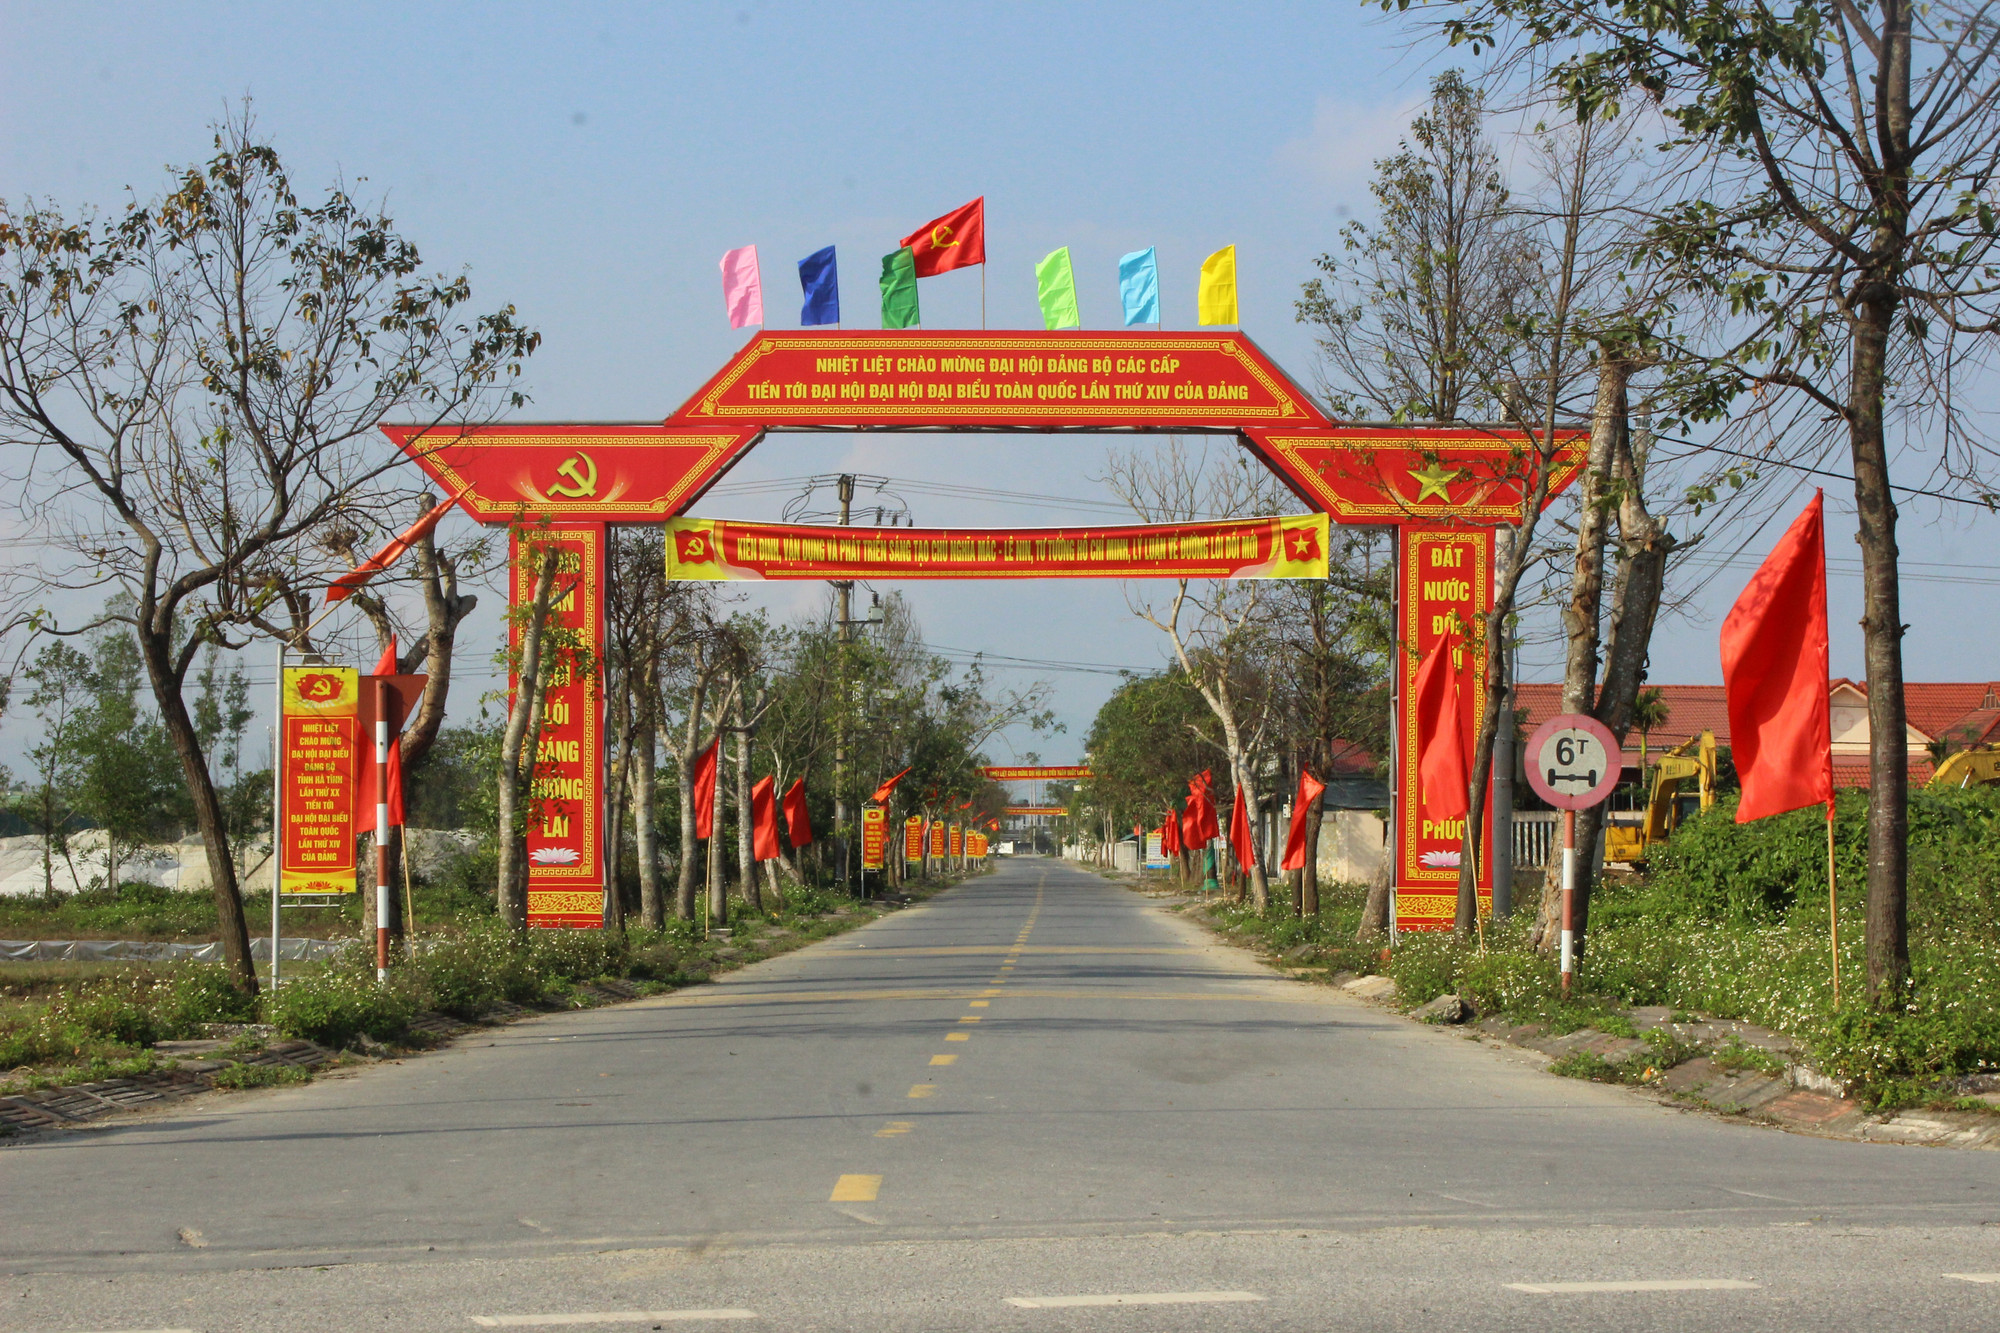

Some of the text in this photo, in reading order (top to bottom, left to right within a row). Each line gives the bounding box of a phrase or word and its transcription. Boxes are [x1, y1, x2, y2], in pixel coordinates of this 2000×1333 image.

[816, 353, 1180, 376] NHIỆT LIỆT CHÀO MỪNG ĐẠI HỘI ĐẢNG BỘ CÁC CẤP
[747, 378, 1248, 401] TIẾN TỚI ĐẠI HỘI ĐẠI HỘI ĐẠI BIỂU TOÀN QUỐC LẦN THỨ XIV CỦA ĐẢNG
[737, 533, 757, 561] KIÊN
[759, 538, 781, 566] ĐỊNH,
[783, 534, 800, 566] VẬN
[802, 539, 825, 567] DỤNG
[827, 534, 838, 561] VÀ
[840, 534, 860, 561] PHÁT
[863, 531, 887, 562] TRIỂN
[889, 534, 911, 562] SÁNG
[913, 540, 929, 567] TẠO
[931, 531, 948, 562] CHỦ
[950, 535, 976, 562] NGHĨA
[977, 535, 996, 562] MÁC
[1004, 535, 1014, 561] LÊ
[1016, 540, 1033, 564] NIN,
[1035, 537, 1047, 561] TƯ
[1048, 530, 1075, 561] TƯỞNG
[1076, 532, 1088, 561] HỒ
[1090, 534, 1104, 561] CHÍ
[1106, 538, 1131, 563] MINH,
[1132, 533, 1142, 560] LÝ
[1144, 533, 1166, 565] LUẬN
[1168, 529, 1178, 560] VỀ
[1180, 530, 1208, 560] ĐƯỜNG
[1210, 528, 1223, 559] LỐI
[1225, 527, 1240, 559] ĐỔI
[1241, 528, 1258, 559] MỚI
[1431, 541, 1463, 567] ĐẤT
[1424, 577, 1470, 601] NƯỚC
[302, 722, 339, 734] NHIỆT LIỆT
[300, 735, 341, 745] CHÀO MỪNG
[536, 736, 579, 762] SÁNG
[292, 746, 349, 760] ĐẠI HỘI ĐẠI BIỂU
[305, 798, 334, 810] TIẾN TỚI
[300, 824, 339, 836] TOÀN QUỐC
[543, 815, 568, 837] LAI
[1422, 816, 1465, 840] PHÚC
[298, 837, 341, 848] LẦN THỨ XIV
[302, 849, 337, 861] CỦA ĐẢNG
